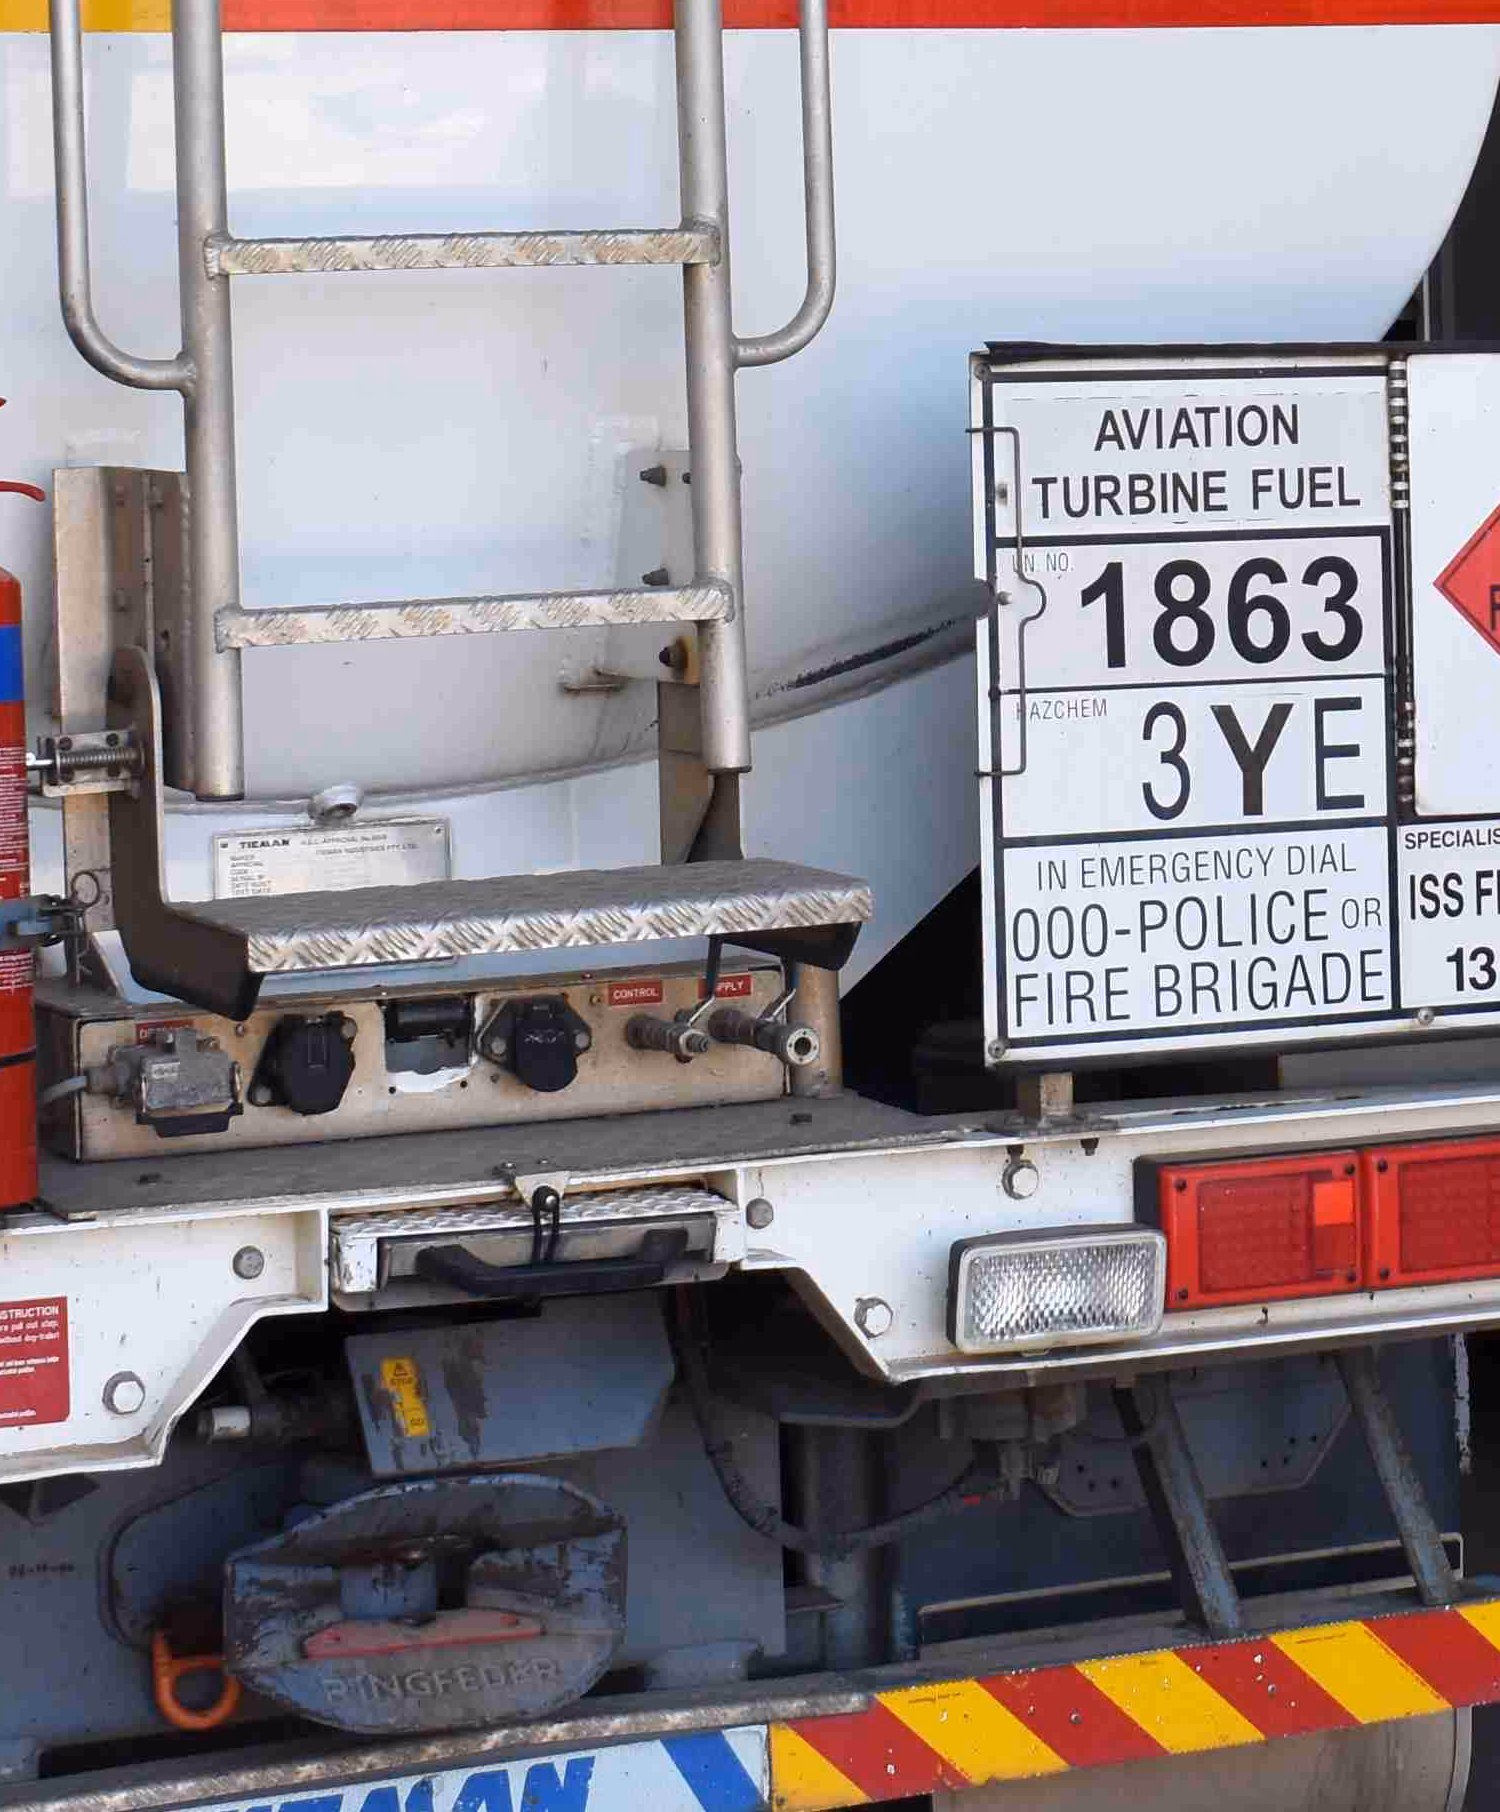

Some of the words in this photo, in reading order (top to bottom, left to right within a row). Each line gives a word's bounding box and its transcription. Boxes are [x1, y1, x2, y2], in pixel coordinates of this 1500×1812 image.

[1095, 403, 1299, 451] AVIATION
[1032, 470, 1228, 519] TURBINE
[1252, 466, 1361, 510] FUEL
[1046, 552, 1074, 572] NO.
[1081, 555, 1363, 668] 1863
[1016, 698, 1108, 720] HAZCHEM
[239, 839, 291, 849] TIEMAN
[1037, 859, 1067, 891] IN
[1081, 846, 1275, 889] EMERGENCY
[1288, 843, 1356, 875] DIAL
[1410, 872, 1464, 920] ISS
[1012, 889, 1329, 962] 000-POLICE
[1341, 897, 1382, 929] OR
[612, 987, 660, 1000] CONTROL
[1015, 966, 1131, 1027] FIRE
[1154, 949, 1385, 1017] BRIGADE
[26, 1321, 38, 1329] out
